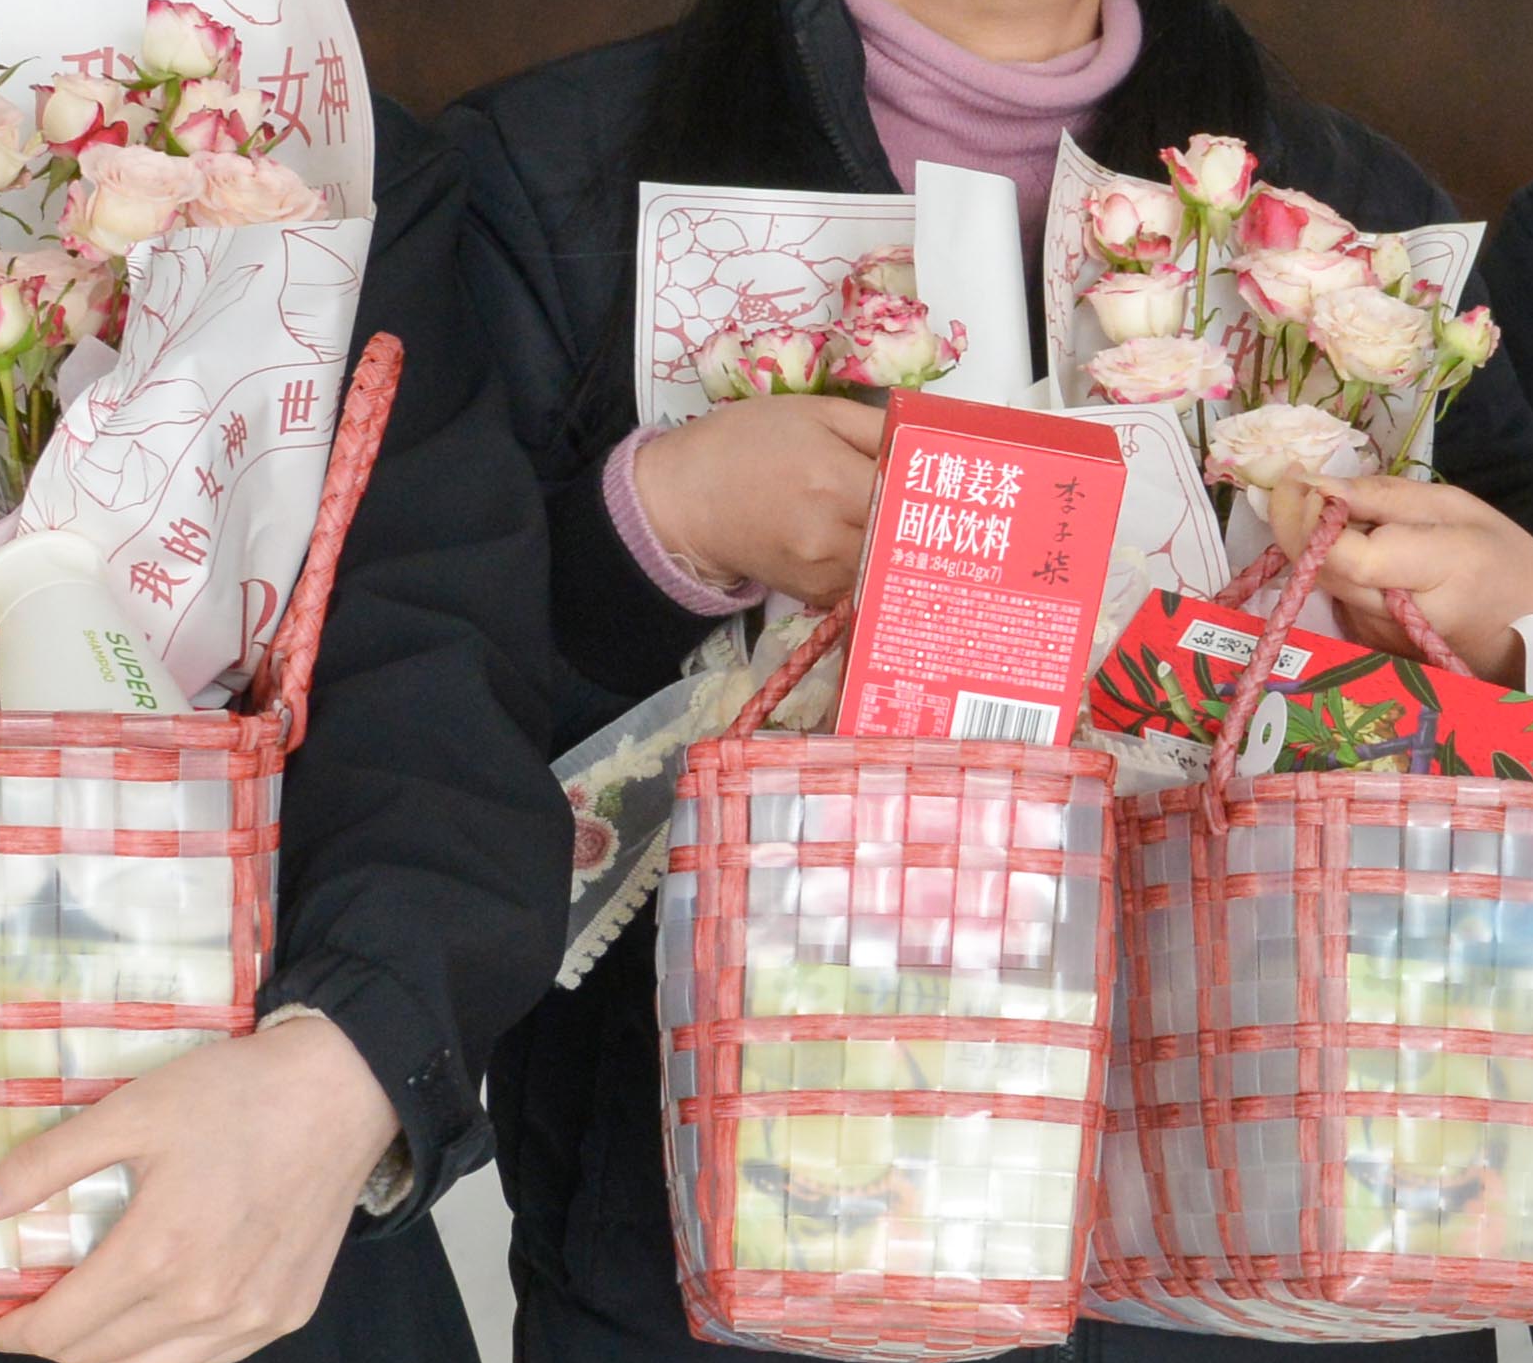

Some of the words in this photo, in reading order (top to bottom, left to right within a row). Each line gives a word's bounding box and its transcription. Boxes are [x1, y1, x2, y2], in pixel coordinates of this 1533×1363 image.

[130, 410, 249, 610] 我的女神
[904, 448, 1024, 509] 红糖姜茶
[894, 499, 1012, 561] 固体饮料
[1032, 476, 1086, 586] 李子柒
[83, 629, 116, 684] SHAMPOO
[105, 631, 157, 710] SUPER
